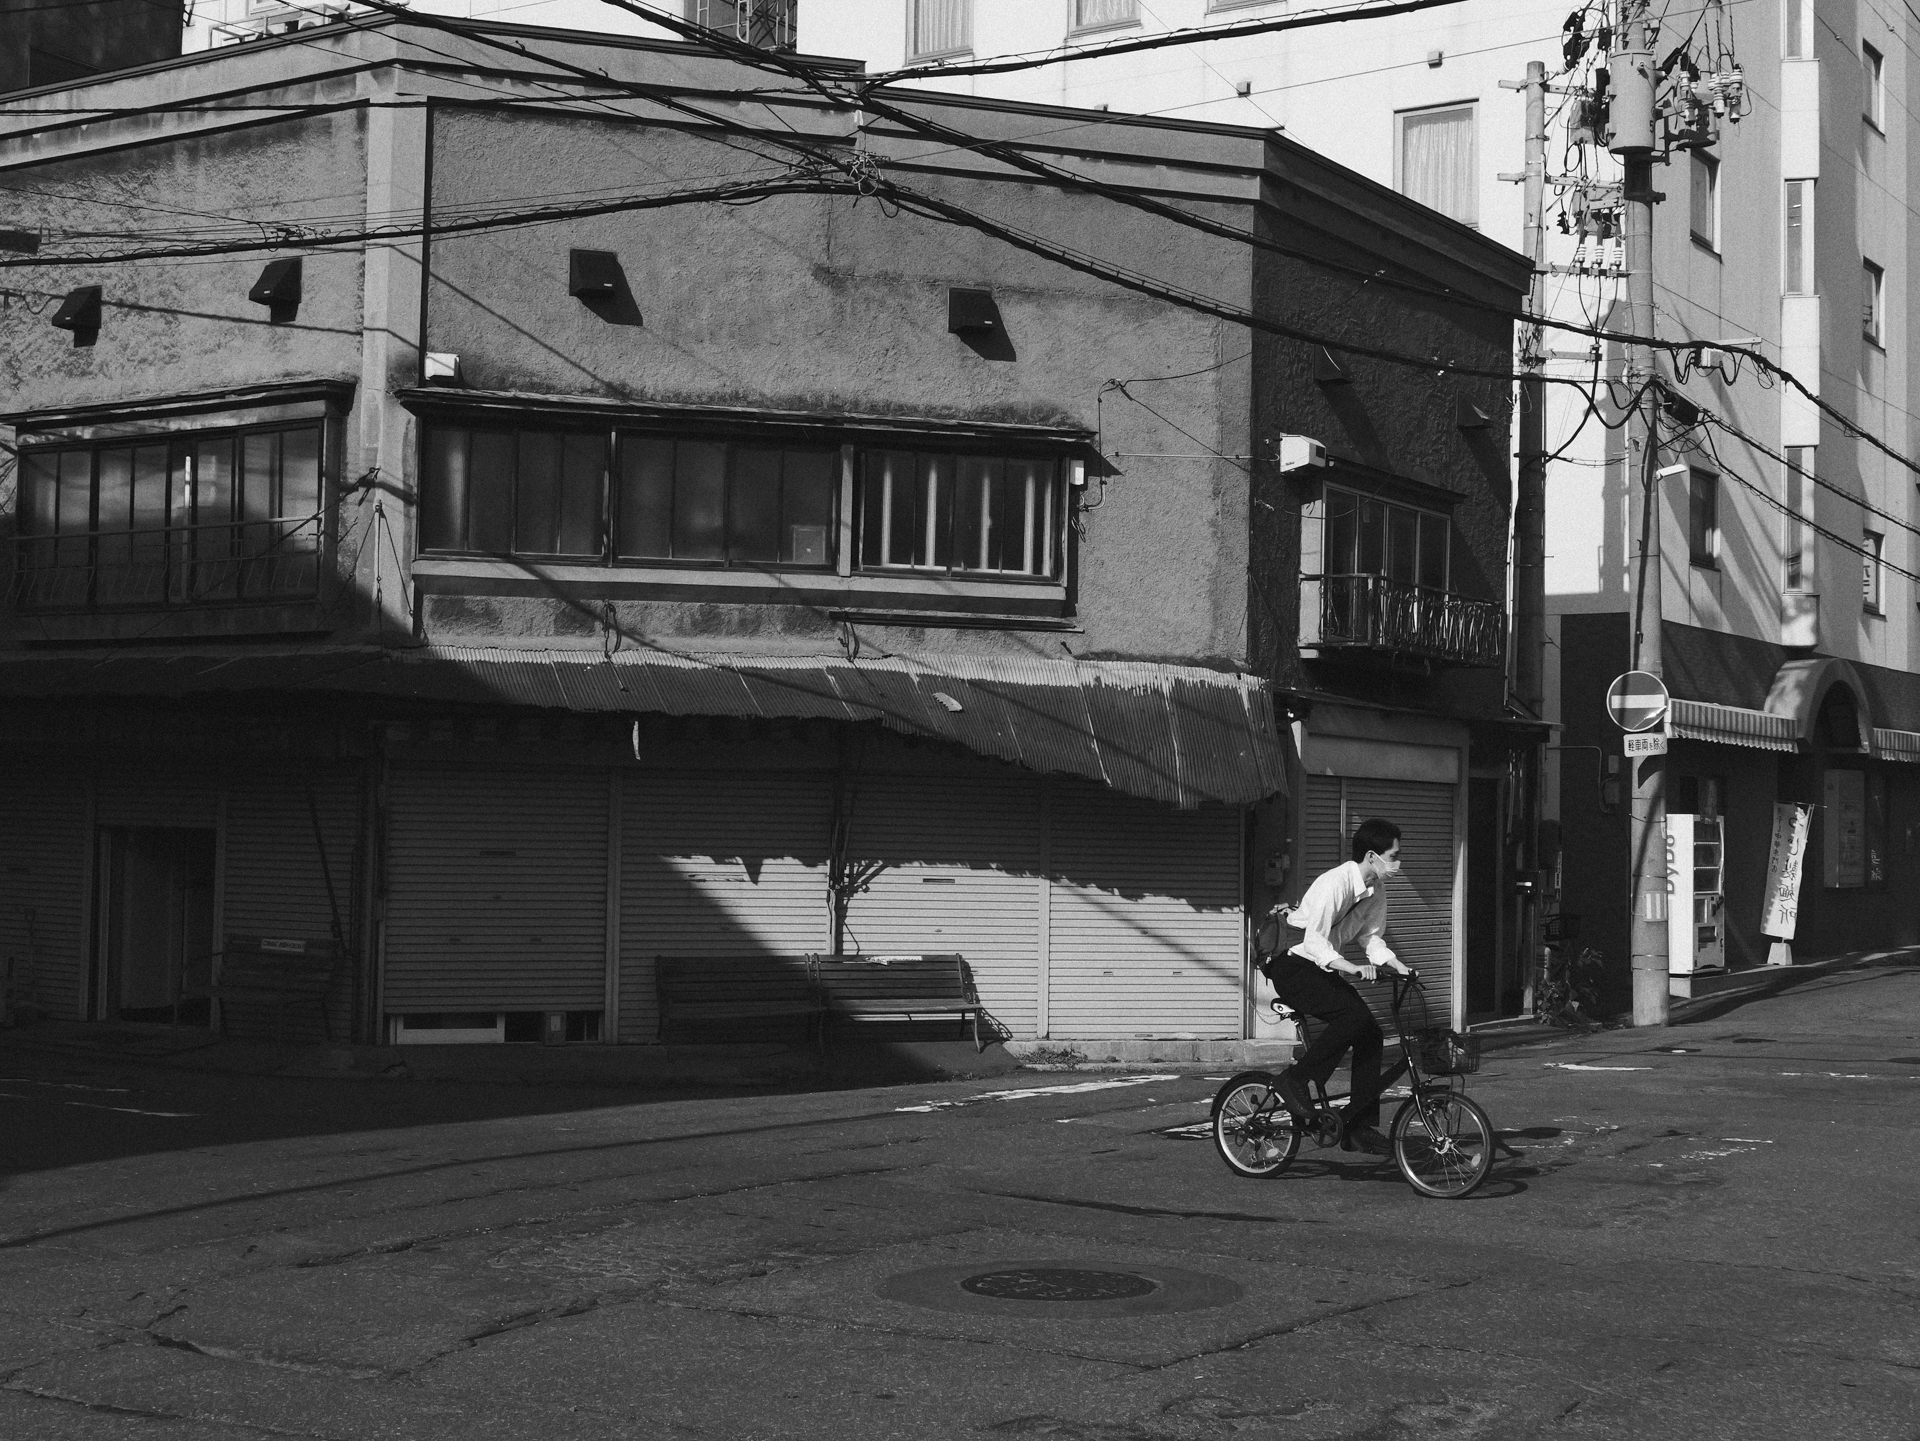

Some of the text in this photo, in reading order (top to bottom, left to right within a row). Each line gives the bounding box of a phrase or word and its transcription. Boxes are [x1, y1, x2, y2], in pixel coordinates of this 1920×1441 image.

[1628, 737, 1665, 752] 軽車両を除く
